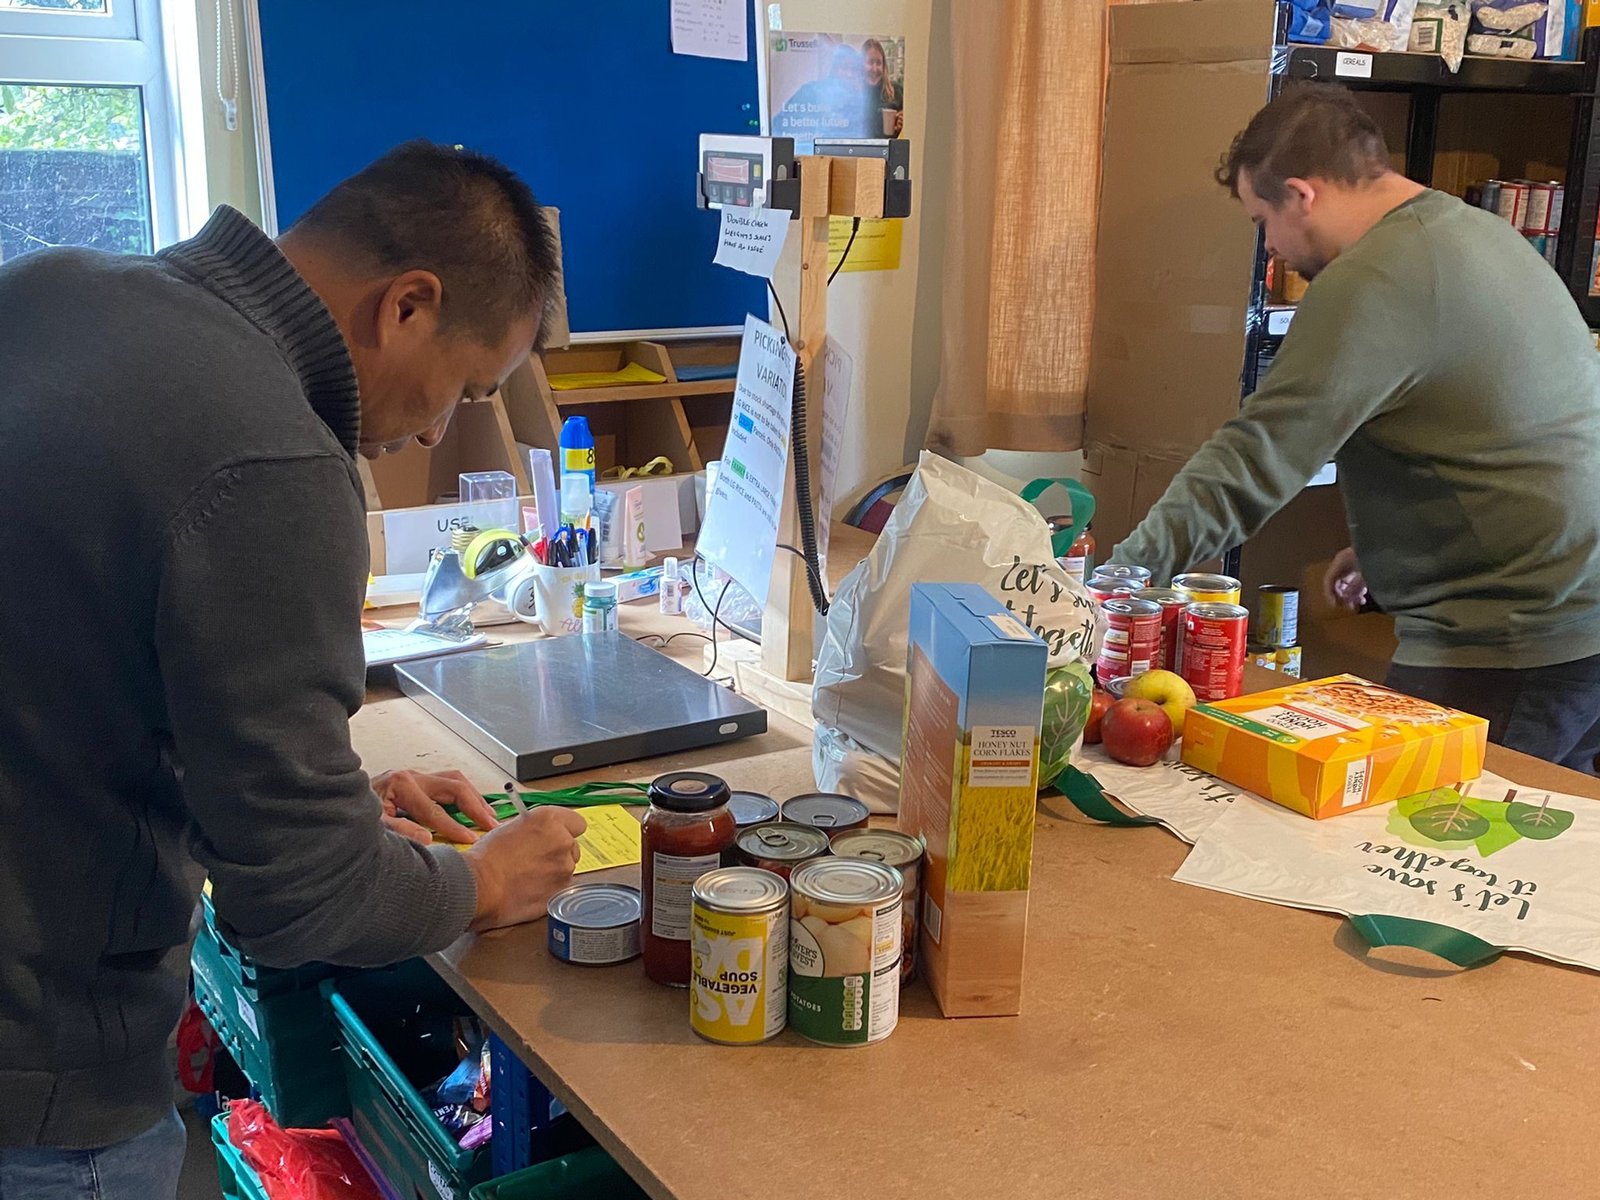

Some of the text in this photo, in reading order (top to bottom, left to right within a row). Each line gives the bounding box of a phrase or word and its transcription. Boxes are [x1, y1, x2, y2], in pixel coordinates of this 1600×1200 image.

[1343, 57, 1366, 66] CEREALS
[782, 117, 850, 127] a better future
[1001, 555, 1064, 603] Let's
[1021, 604, 1095, 657] togeth
[991, 729, 1017, 737] TESCO
[978, 741, 1026, 749] HONEY NUT
[973, 749, 1031, 757] CORN FLAKES
[1353, 841, 1538, 897] it together
[1362, 863, 1531, 921] Let's save
[719, 971, 758, 981] SOUP
[693, 970, 758, 995] VEGETABLE
